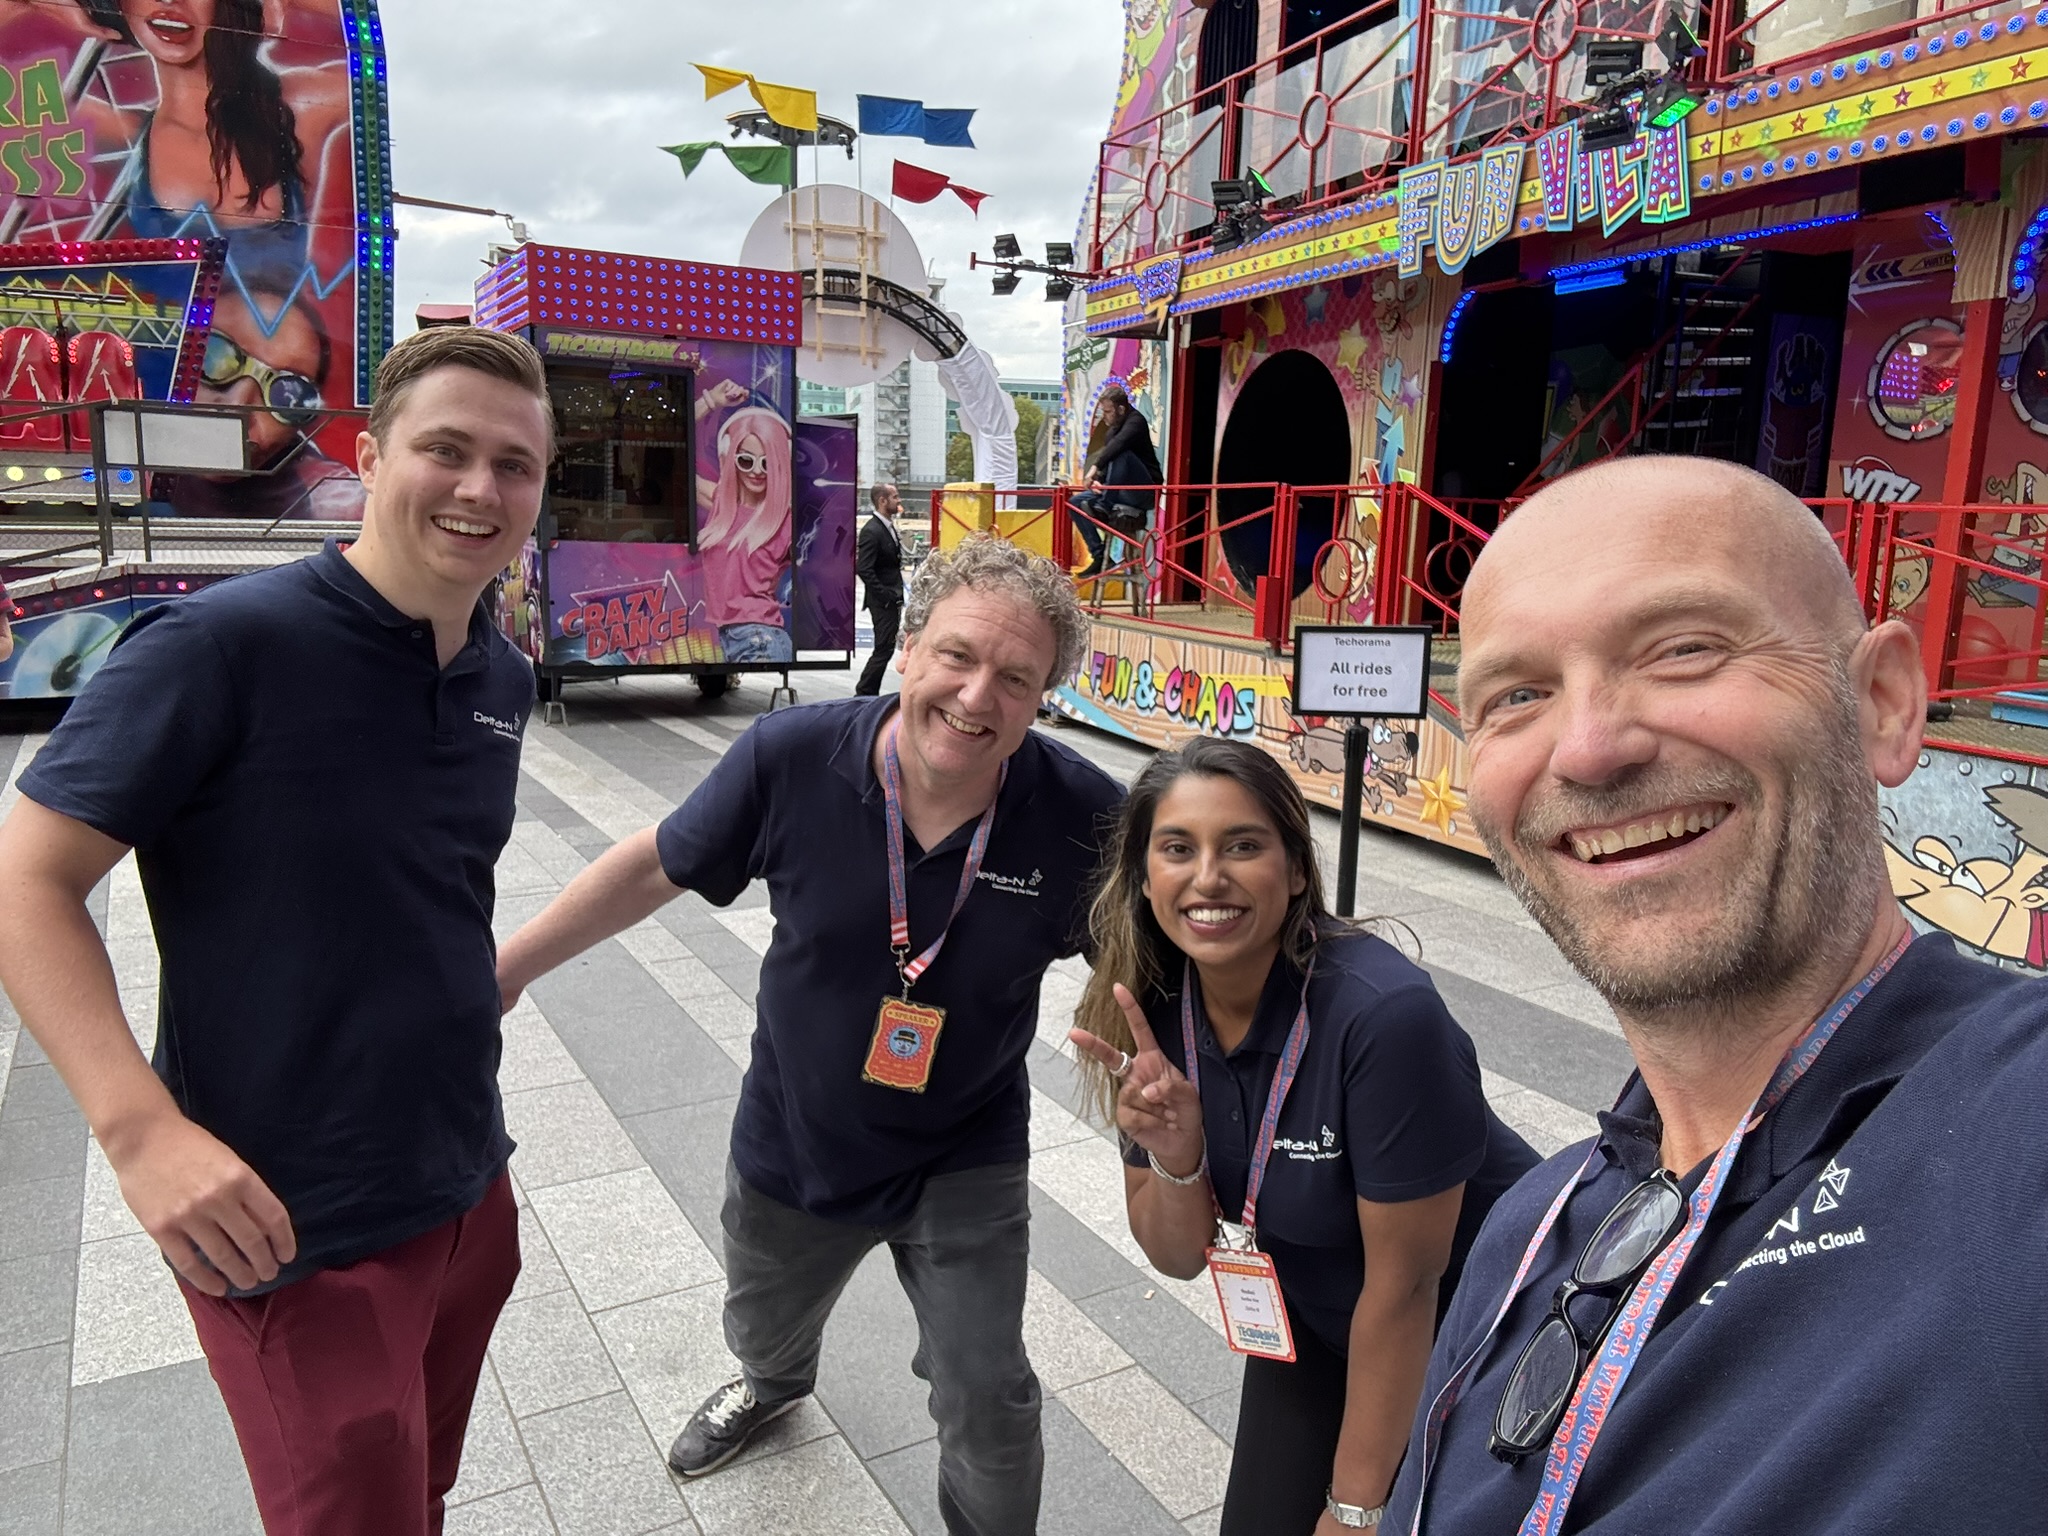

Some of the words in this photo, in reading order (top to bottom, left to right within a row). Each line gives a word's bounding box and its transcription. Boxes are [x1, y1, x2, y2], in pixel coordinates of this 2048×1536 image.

[1399, 142, 1526, 278] FUN
[546, 333, 681, 363] TICKETBOX
[561, 587, 666, 638] CRAZY
[586, 607, 689, 659] DANCE
[1334, 637, 1391, 647] Techorama
[1330, 662, 1350, 675] All
[1354, 662, 1392, 675] rides
[1090, 651, 1133, 702] FUN
[1135, 660, 1157, 711] &
[1164, 665, 1256, 734] CHAOS
[1333, 684, 1354, 697] for
[1357, 685, 1388, 697] free
[1789, 1239, 1817, 1258] the
[1818, 1225, 1866, 1251] Cloud
